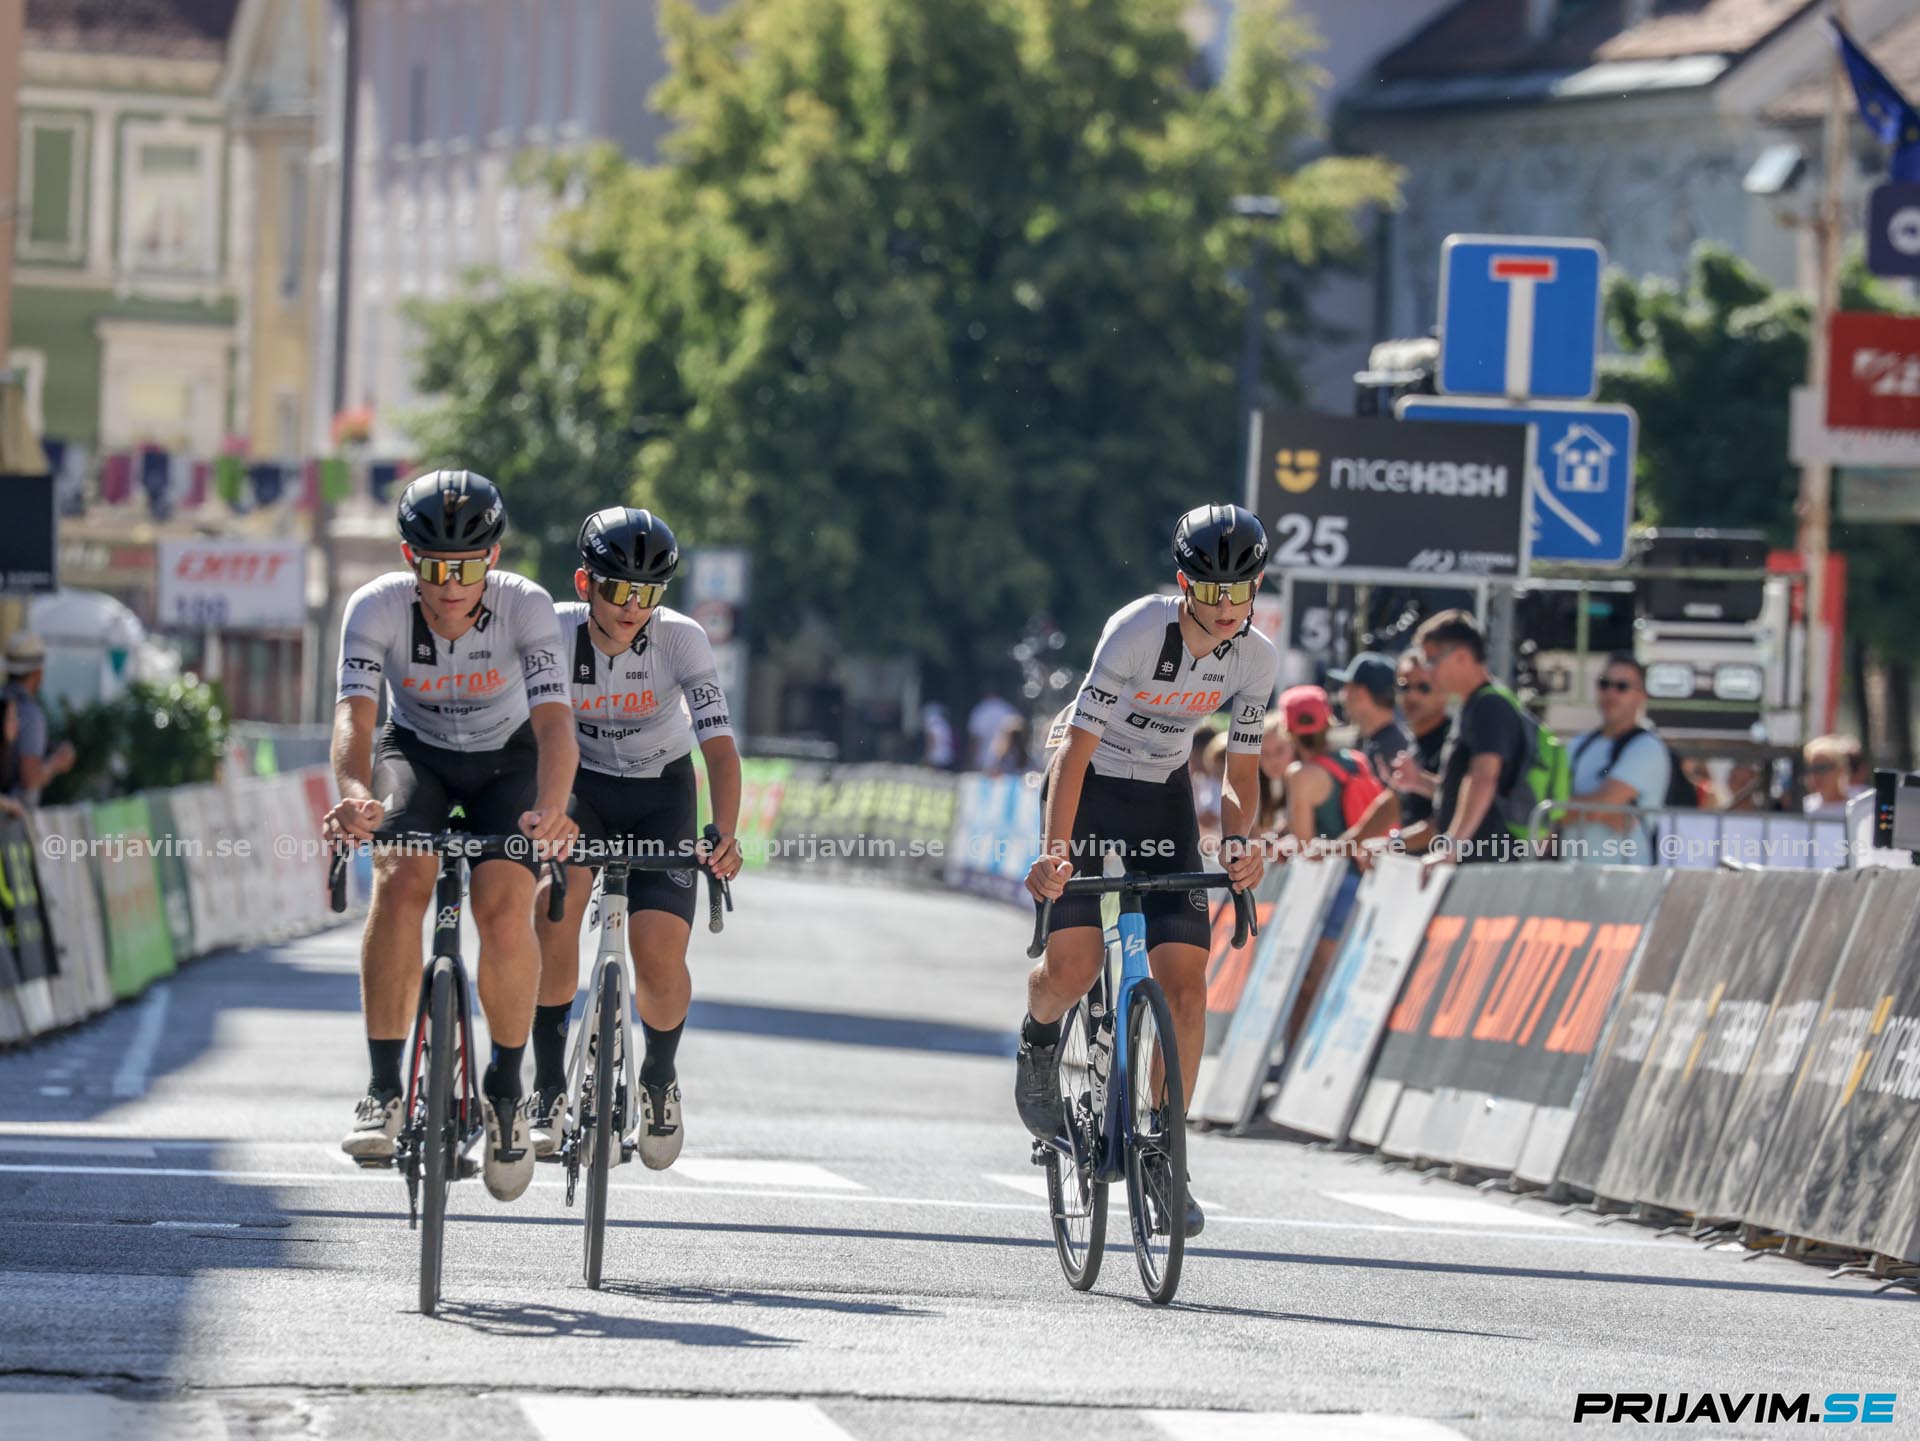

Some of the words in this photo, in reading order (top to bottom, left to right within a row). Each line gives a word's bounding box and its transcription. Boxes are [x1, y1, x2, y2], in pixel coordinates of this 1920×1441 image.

[1273, 512, 1350, 570] 25
[402, 668, 500, 692] FACTOR
[1202, 673, 1225, 683] GOBIK
[1134, 691, 1222, 705] FACTOR
[601, 727, 643, 740] triglav
